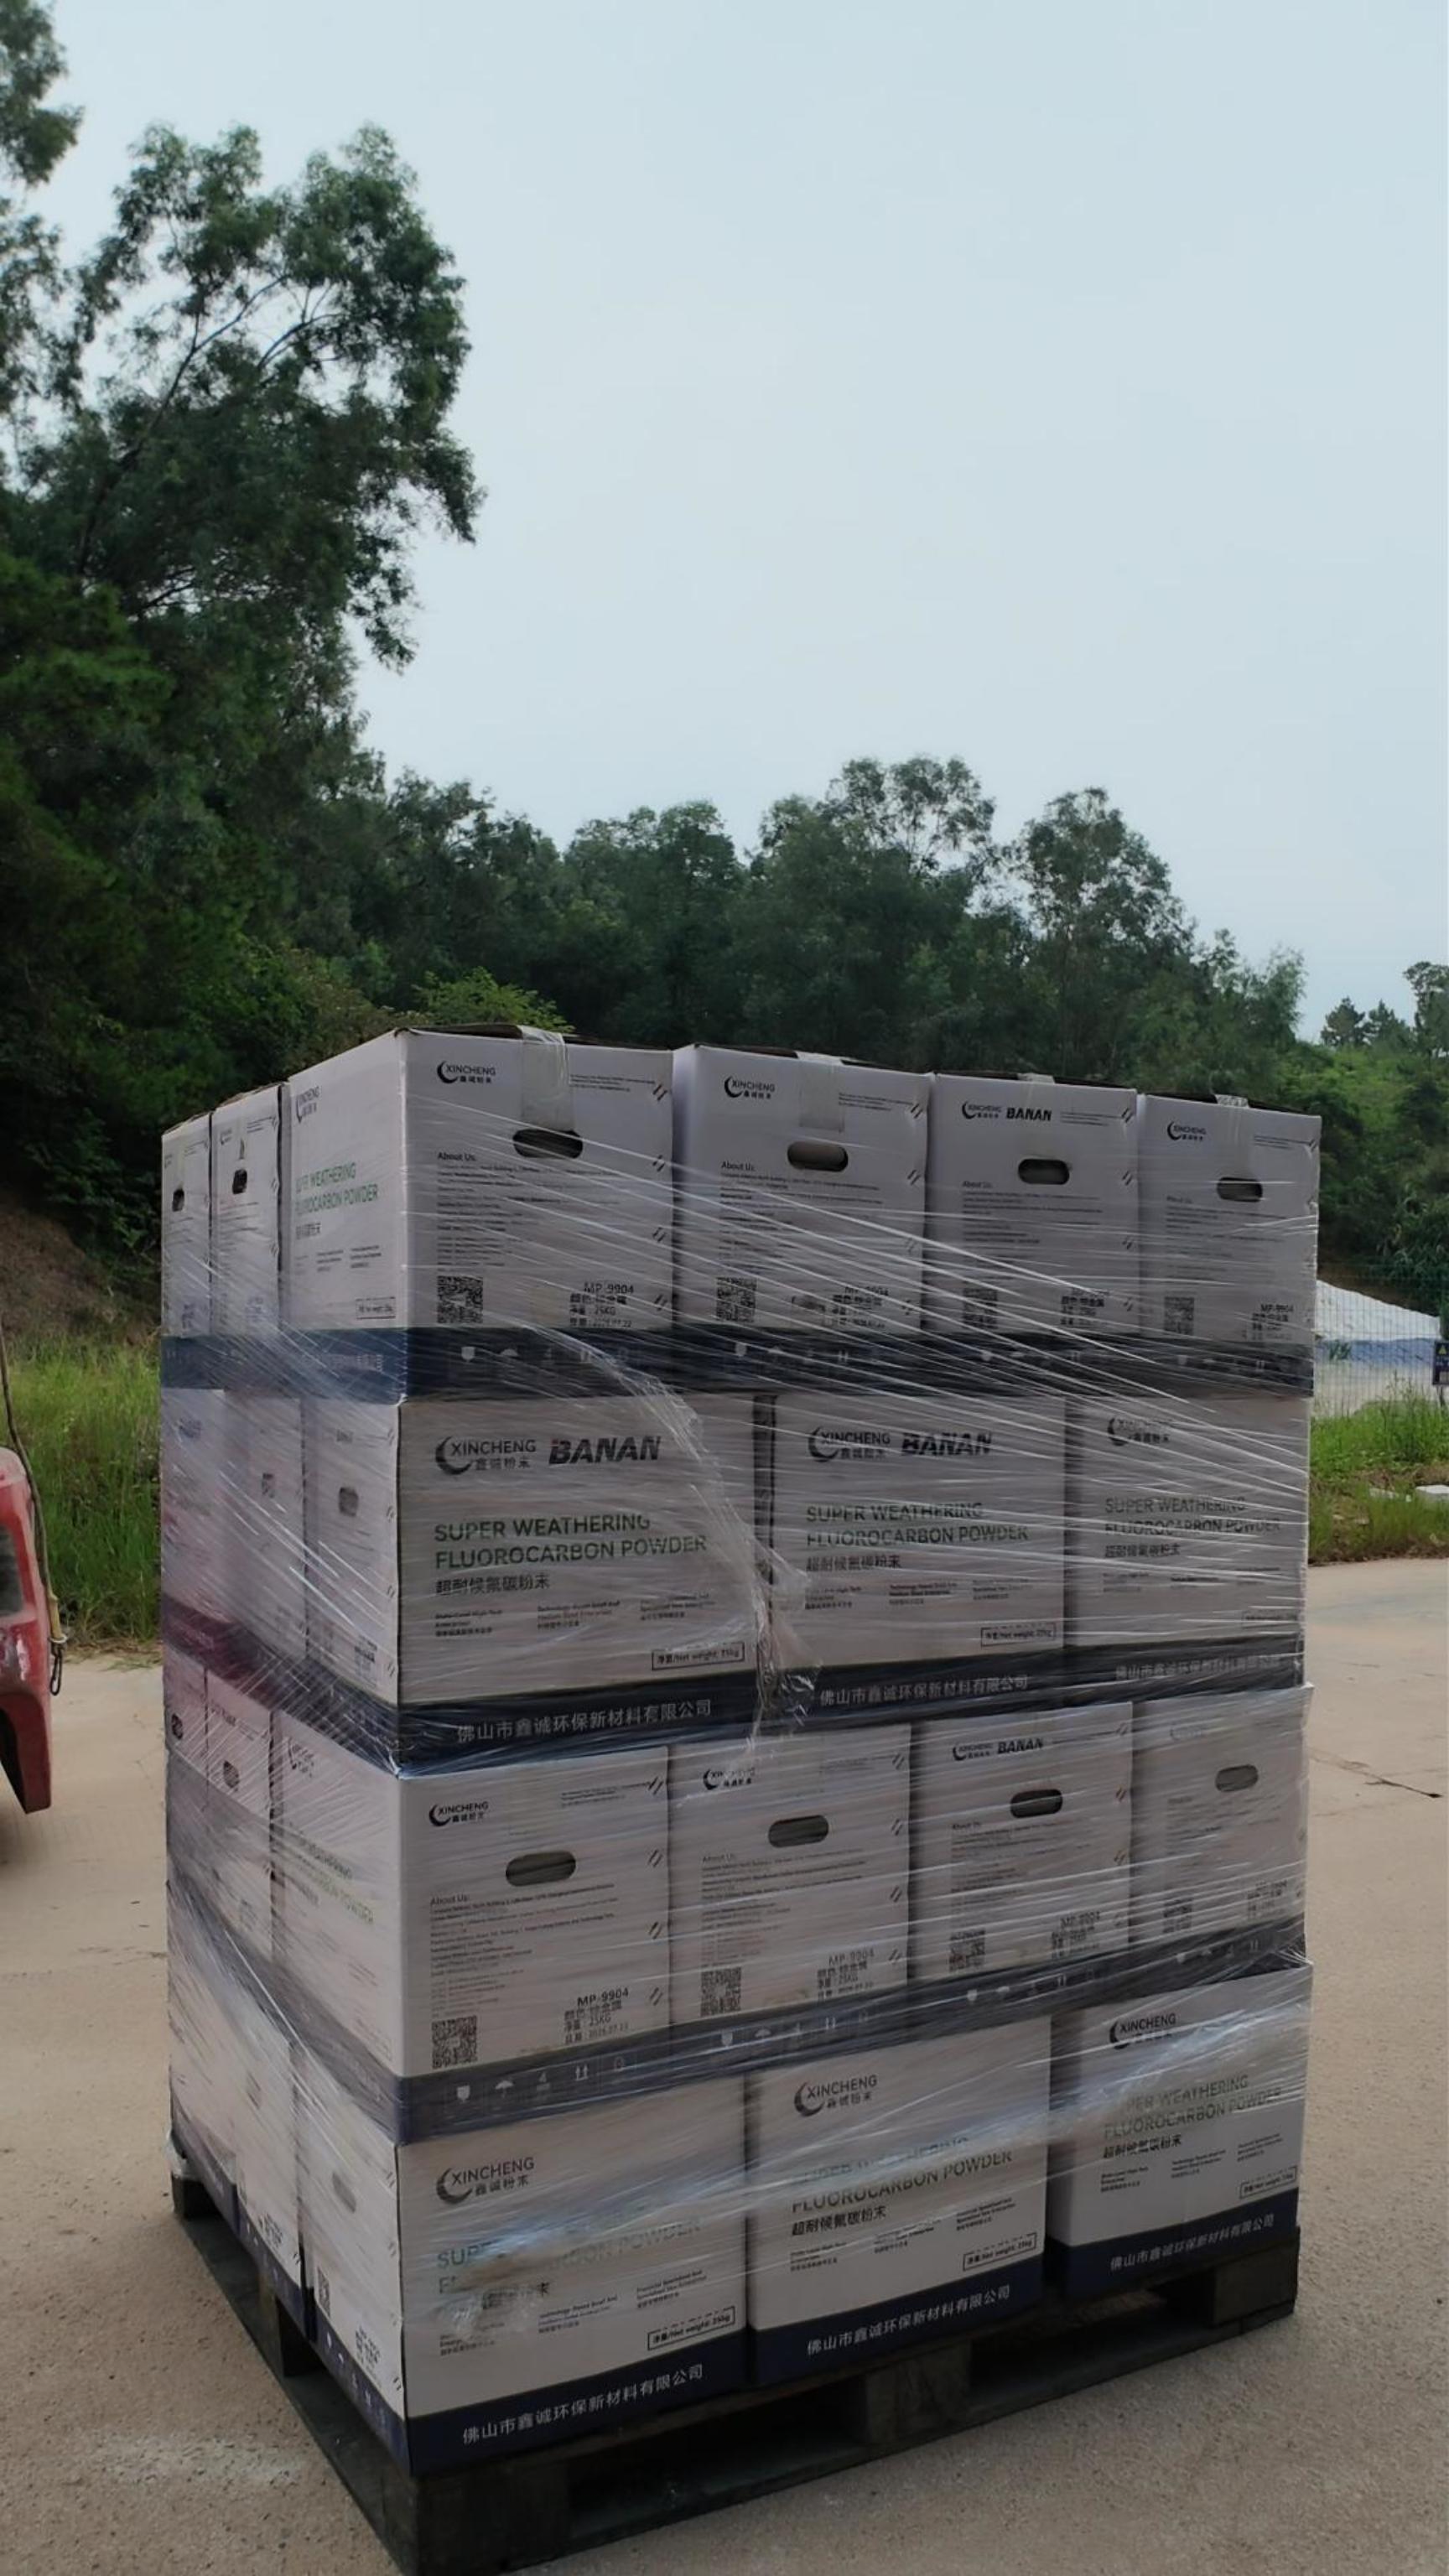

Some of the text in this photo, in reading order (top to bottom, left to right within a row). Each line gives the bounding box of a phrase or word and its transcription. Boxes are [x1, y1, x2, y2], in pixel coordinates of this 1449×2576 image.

[445, 1064, 496, 1076] XINCHENG
[732, 1080, 775, 1092] XINCHENG
[1006, 1107, 1052, 1121] BANAN
[437, 1151, 462, 1162] About
[721, 1160, 745, 1171] About
[345, 1183, 377, 1205] POWDER
[451, 1435, 661, 1465] XINCHENG BANAN
[821, 1431, 993, 1457] XINCHENG BANAN
[474, 1455, 531, 1472] 鑫诚粉末
[807, 1502, 984, 1524] SUPER WEATHERING
[1105, 1496, 1246, 1514] SUPER WEATHERING
[434, 1514, 650, 1542] SUPER WEATHERING
[808, 1524, 1028, 1548] FLUOROCARBON POWDER
[1105, 1517, 1280, 1536] FLUOROCARBON POWDER
[436, 1534, 707, 1570] FLUOROCARBON POWDER
[436, 1572, 549, 1595] 超耐候氟碳粉末
[457, 1699, 712, 1743] 佛山市鑫诚环保新材料有限公司
[997, 1737, 1043, 1755] BANAN
[438, 1801, 489, 1816] XINCHENG
[430, 1895, 455, 1906] About
[577, 1987, 629, 2007] MP-9904
[1120, 2012, 1176, 2035] XINCHENG
[807, 2074, 878, 2101] XINCHENG
[1163, 2074, 1249, 2107] WEATHERING
[1104, 2086, 1283, 2139] FLUOROCARBON POWDER
[451, 2156, 535, 2186] XINCHENG
[792, 2172, 939, 2214] FLUOROCARBON
[943, 2150, 1013, 2180] POWDER
[475, 2174, 530, 2197] 鑫诚粉末
[792, 2205, 887, 2236] 超耐候氟碳粉末
[807, 2283, 1011, 2356] 佛山市鑫诚环保新材料有限公司
[463, 2363, 704, 2446] 佛山市鑫诚环保新材料有限公司
